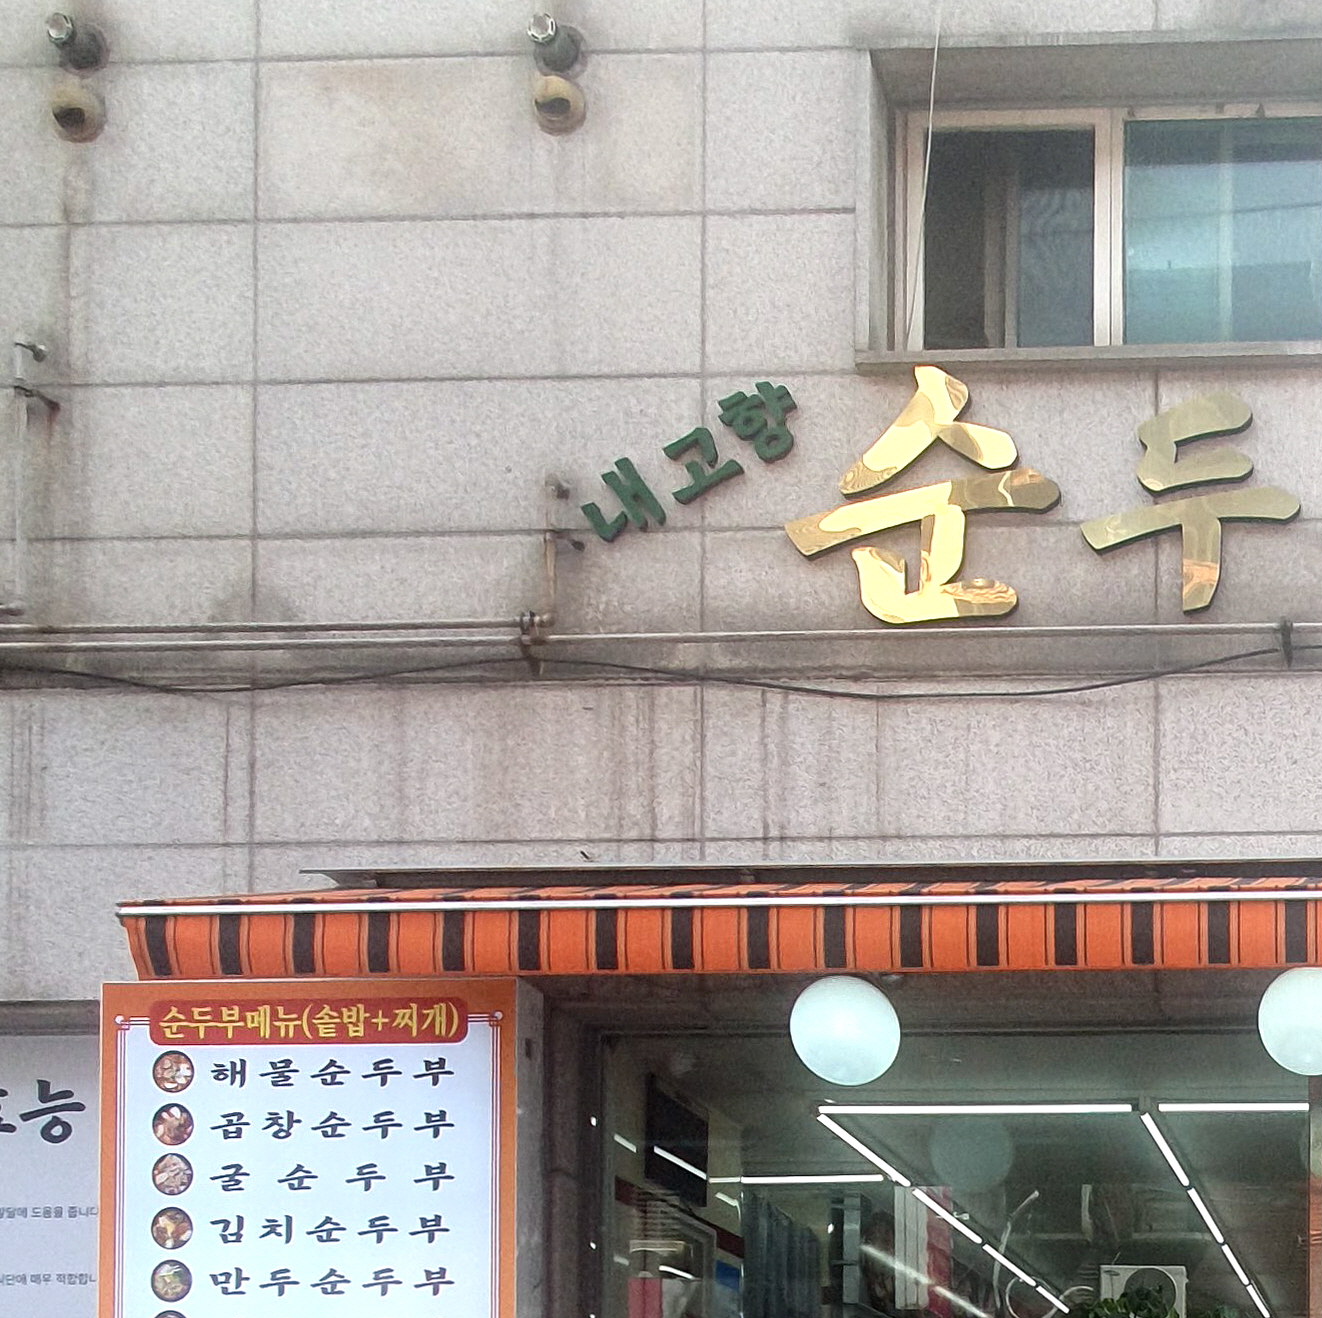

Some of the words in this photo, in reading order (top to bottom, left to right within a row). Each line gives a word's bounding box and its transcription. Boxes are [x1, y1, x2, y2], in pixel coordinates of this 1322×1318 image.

[582, 379, 798, 541] 내고향
[159, 1003, 459, 1041] 순두부메뉴(솥밥+찌개)
[210, 1057, 455, 1088] 해물순두부
[0, 1079, 86, 1143] 능
[210, 1110, 455, 1140] 곱창순두부
[210, 1214, 451, 1245] 김치순두부
[209, 1267, 456, 1297] 만두순두부
